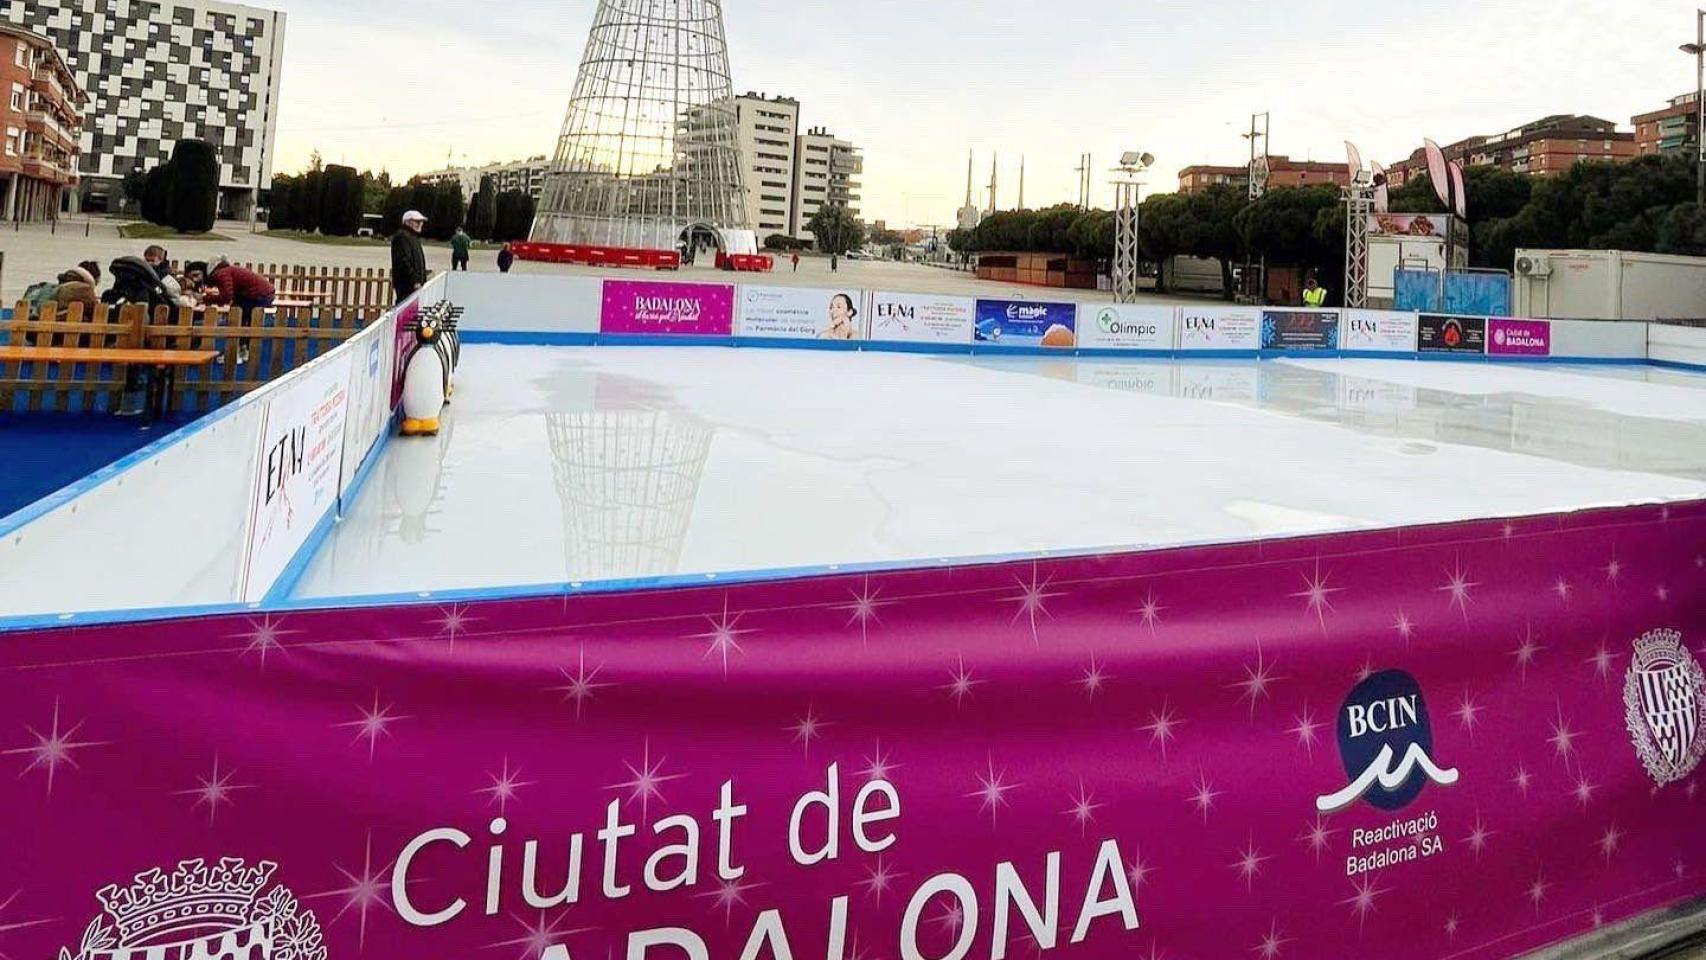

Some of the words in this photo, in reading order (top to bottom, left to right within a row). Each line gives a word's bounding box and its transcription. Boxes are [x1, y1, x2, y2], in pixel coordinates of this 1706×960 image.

[635, 296, 701, 312] BADALONA
[877, 302, 915, 320] ETNA
[1186, 317, 1215, 330] ETNA
[1351, 320, 1376, 332] ETNA
[1506, 337, 1545, 347] BADALONA
[1347, 694, 1418, 737] BCIN
[1352, 810, 1438, 848] Reactivació
[391, 779, 747, 926] Ciutat
[788, 762, 900, 865] de
[1346, 843, 1417, 876] Badalona
[1422, 835, 1443, 857] SA
